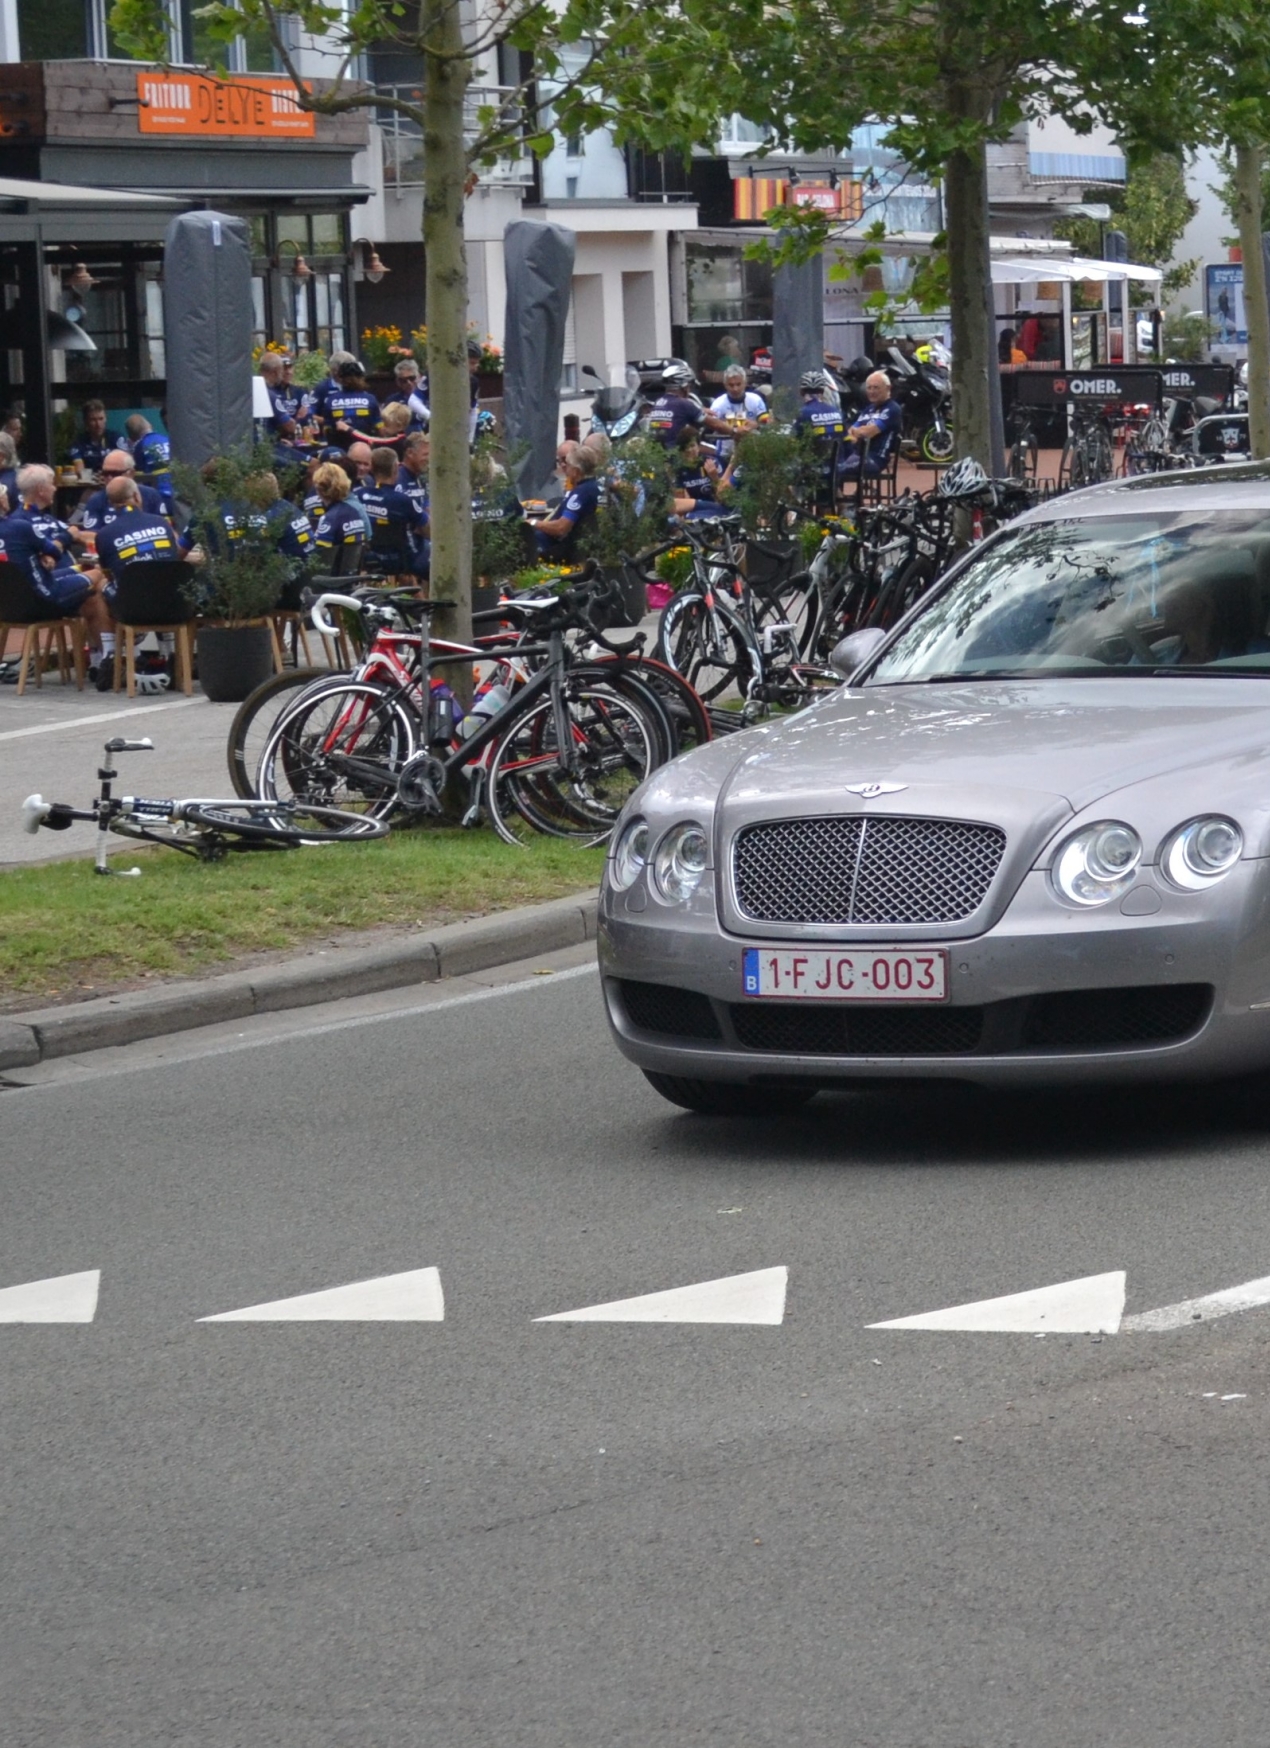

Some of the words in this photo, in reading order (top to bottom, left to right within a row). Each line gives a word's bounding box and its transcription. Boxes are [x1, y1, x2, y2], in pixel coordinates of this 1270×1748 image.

[1070, 379, 1122, 394] OMER.
[332, 397, 369, 406] CASINO
[113, 526, 167, 548] CASINO
[746, 976, 757, 991] B
